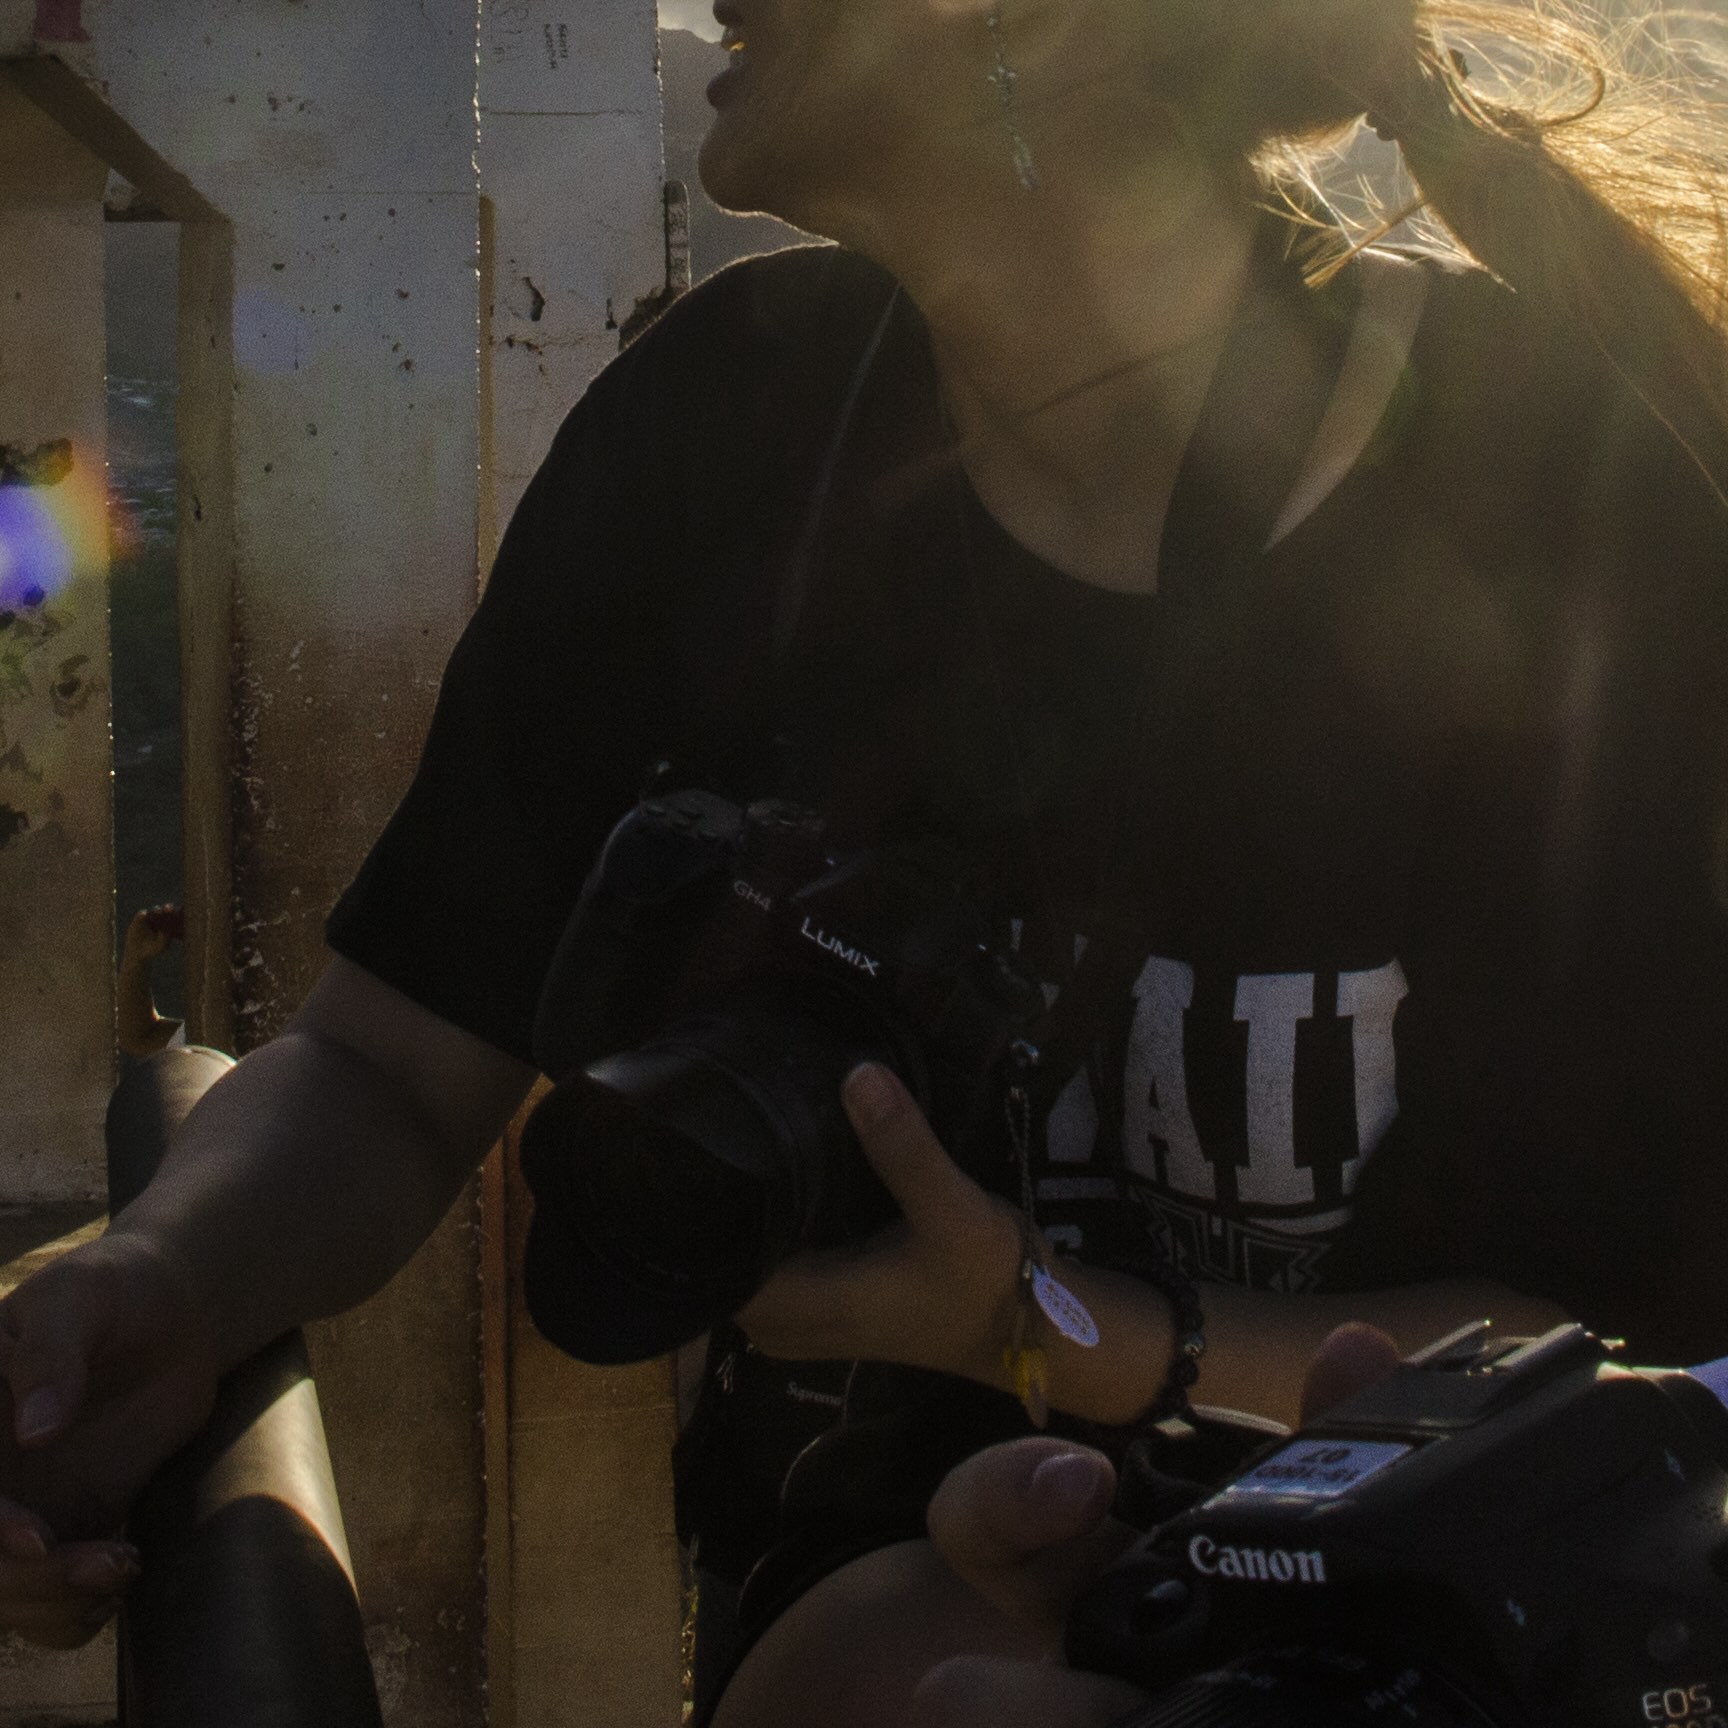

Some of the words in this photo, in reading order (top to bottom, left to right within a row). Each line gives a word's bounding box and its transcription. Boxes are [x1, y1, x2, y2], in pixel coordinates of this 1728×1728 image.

[732, 879, 772, 912] GH4
[800, 915, 881, 978] LUMIX
[1187, 1533, 1327, 1583] Canon
[1641, 1682, 1713, 1722] EOS
